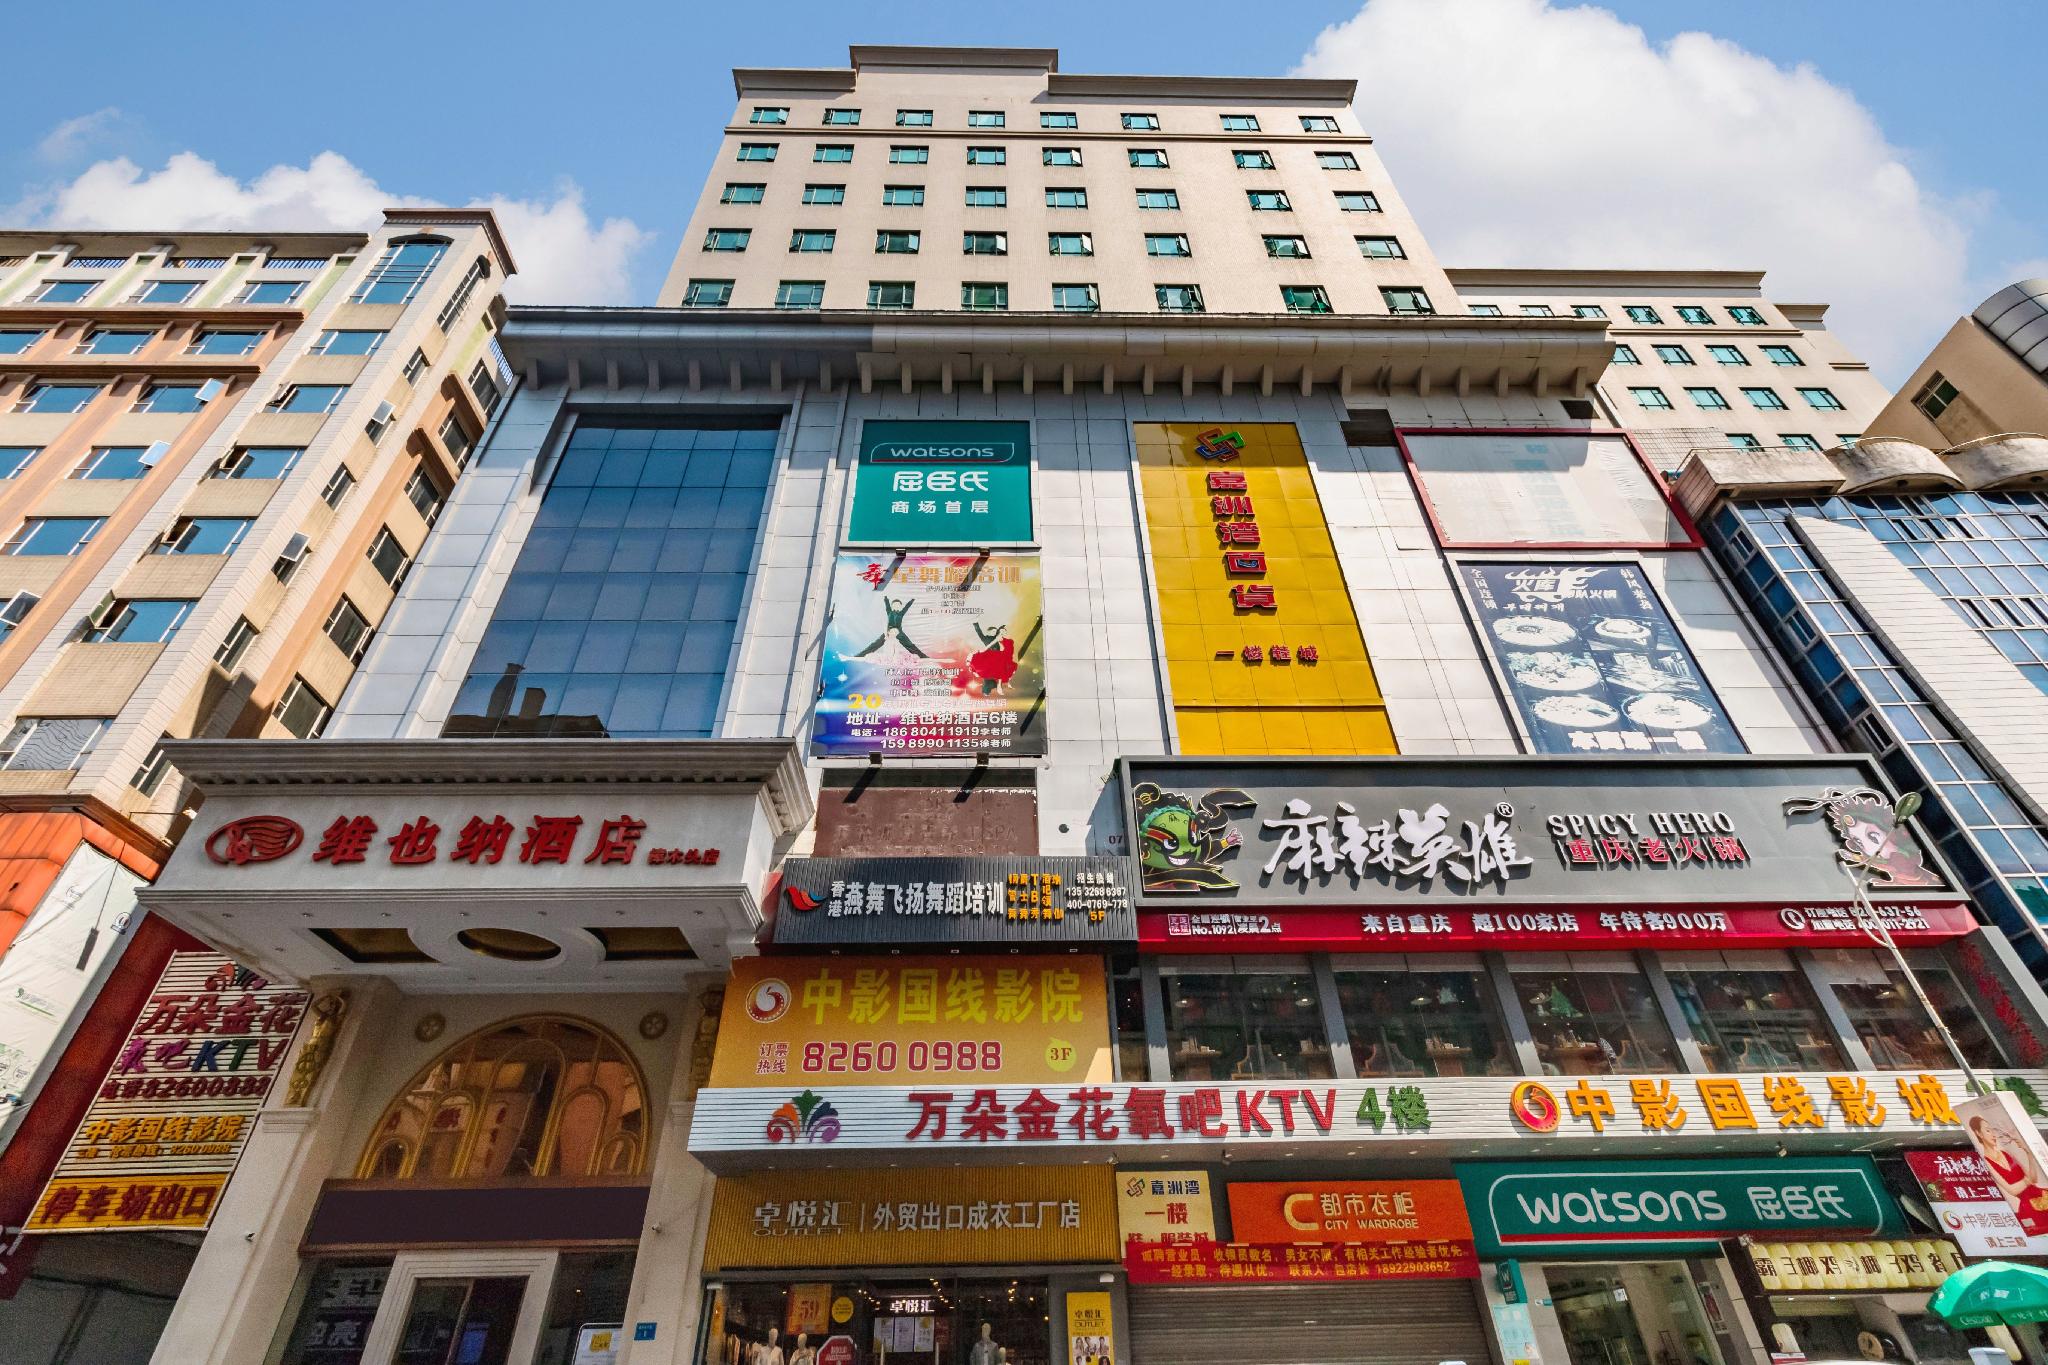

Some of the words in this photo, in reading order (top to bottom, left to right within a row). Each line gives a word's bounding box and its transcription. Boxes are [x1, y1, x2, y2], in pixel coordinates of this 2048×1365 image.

[890, 446, 995, 458] watsons
[893, 471, 989, 492] 屈臣氏
[891, 501, 989, 514] 商场首层
[847, 693, 882, 709] 20
[1548, 813, 1639, 837] SPICY
[1649, 811, 1735, 835] HERO
[312, 814, 646, 866] 维也纳酒店
[1262, 799, 1533, 882] 麻辣英雄
[1566, 836, 1747, 864] 重庆老火锅
[1090, 911, 1105, 921] 5F
[1362, 914, 1453, 934] 来自重庆
[1472, 913, 1579, 933] 超100家店
[1600, 911, 1727, 932] 年待客900万
[803, 967, 1084, 1025] 中影国线影院
[134, 992, 308, 1034] 万朵金花
[760, 1042, 790, 1057] 订票
[802, 1040, 898, 1073] 8260
[907, 1040, 1003, 1073] 0988
[1049, 1046, 1072, 1062] 3F
[756, 1058, 787, 1074] 热线
[1356, 1086, 1432, 1130] 4楼
[1565, 1074, 1962, 1132] 中影国线影城
[86, 1116, 245, 1143] 中影国线影院
[1151, 1180, 1200, 1195] 嘉洲湾
[40, 1184, 216, 1224] 停车场出口
[752, 1200, 851, 1227] 卓悦汇
[873, 1200, 1080, 1231] 外贸出口成衣工厂店
[1145, 1203, 1188, 1224] 一楼
[1320, 1192, 1416, 1216] 都市衣柜
[1516, 1187, 1726, 1224] watsons
[1747, 1185, 1852, 1221] 屈臣氏
[1325, 1220, 1349, 1230] CITY
[1357, 1218, 1419, 1229] WARDROBE
[1963, 1212, 2020, 1228] 中影国线
[754, 1228, 841, 1236] OUTLET
[890, 1300, 935, 1313] 卓悦汇
